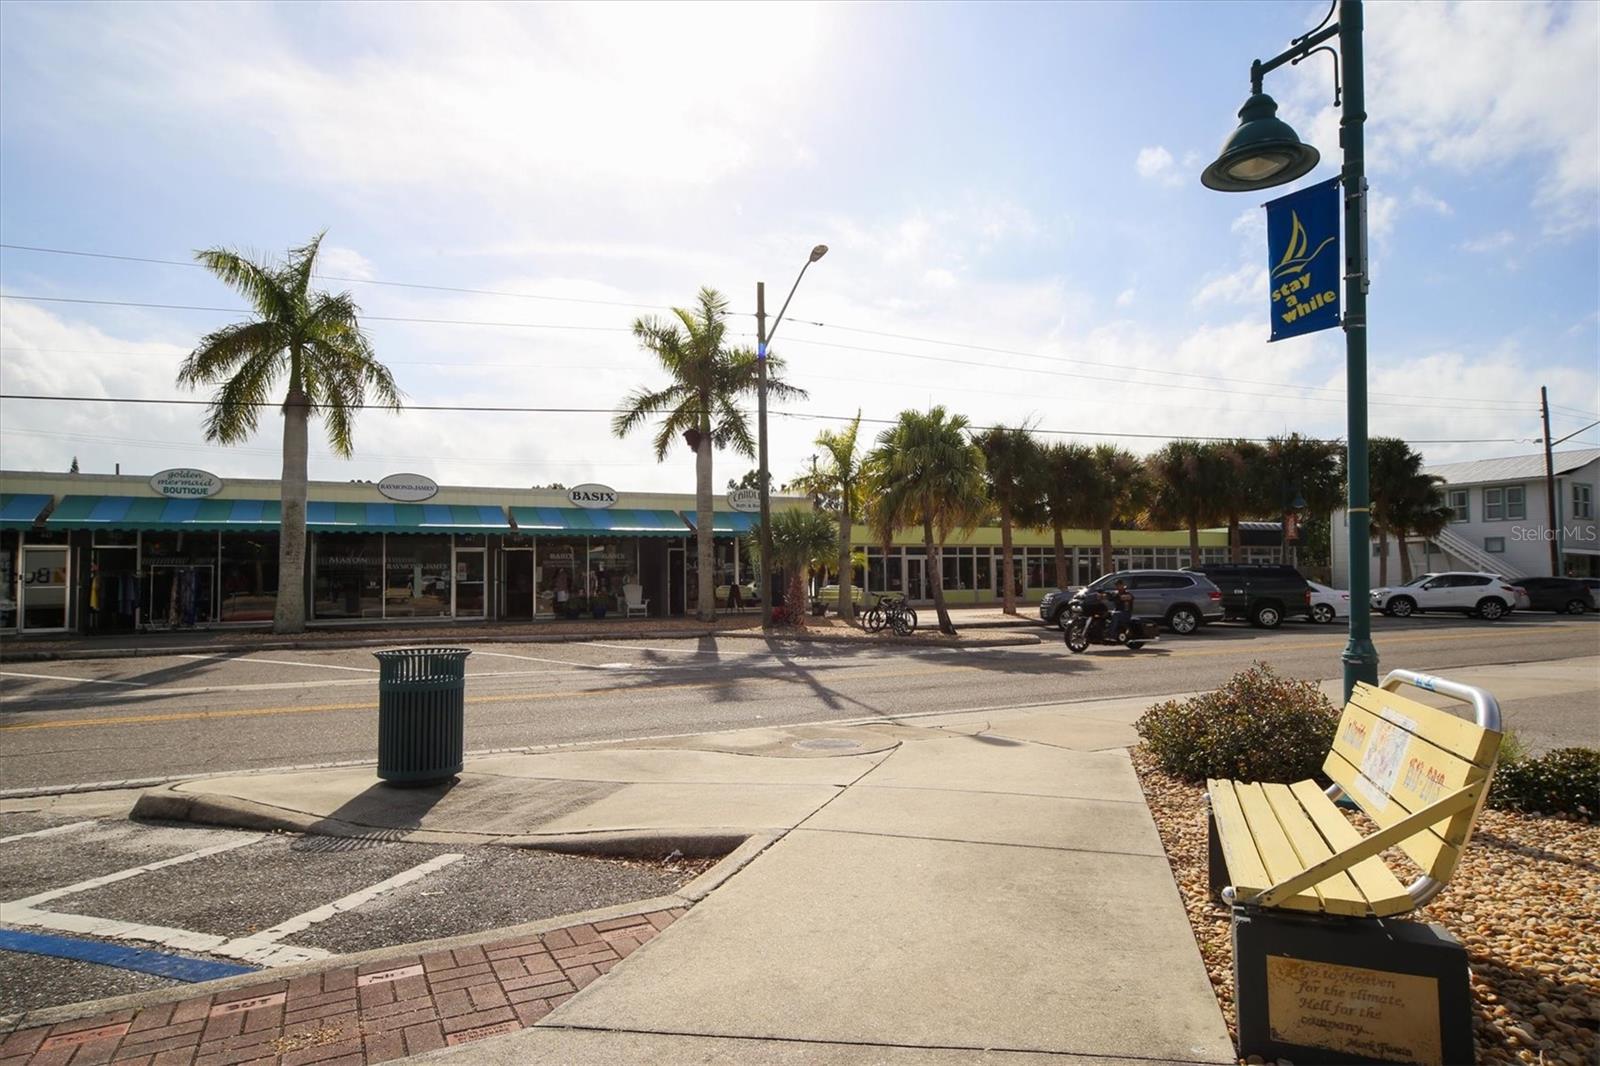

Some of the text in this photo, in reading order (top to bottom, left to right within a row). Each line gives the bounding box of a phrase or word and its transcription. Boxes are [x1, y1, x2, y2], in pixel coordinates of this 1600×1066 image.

[1271, 272, 1311, 302] stay
[1281, 290, 1336, 323] while
[1285, 294, 1298, 307] a
[167, 470, 203, 480] golden
[163, 486, 209, 495] BOUTIQUE
[572, 491, 615, 501] BASIX
[1340, 972, 1396, 988] Heaven
[1296, 980, 1319, 994] for
[1324, 984, 1346, 997] the
[1299, 997, 1383, 1020] Hell for the
